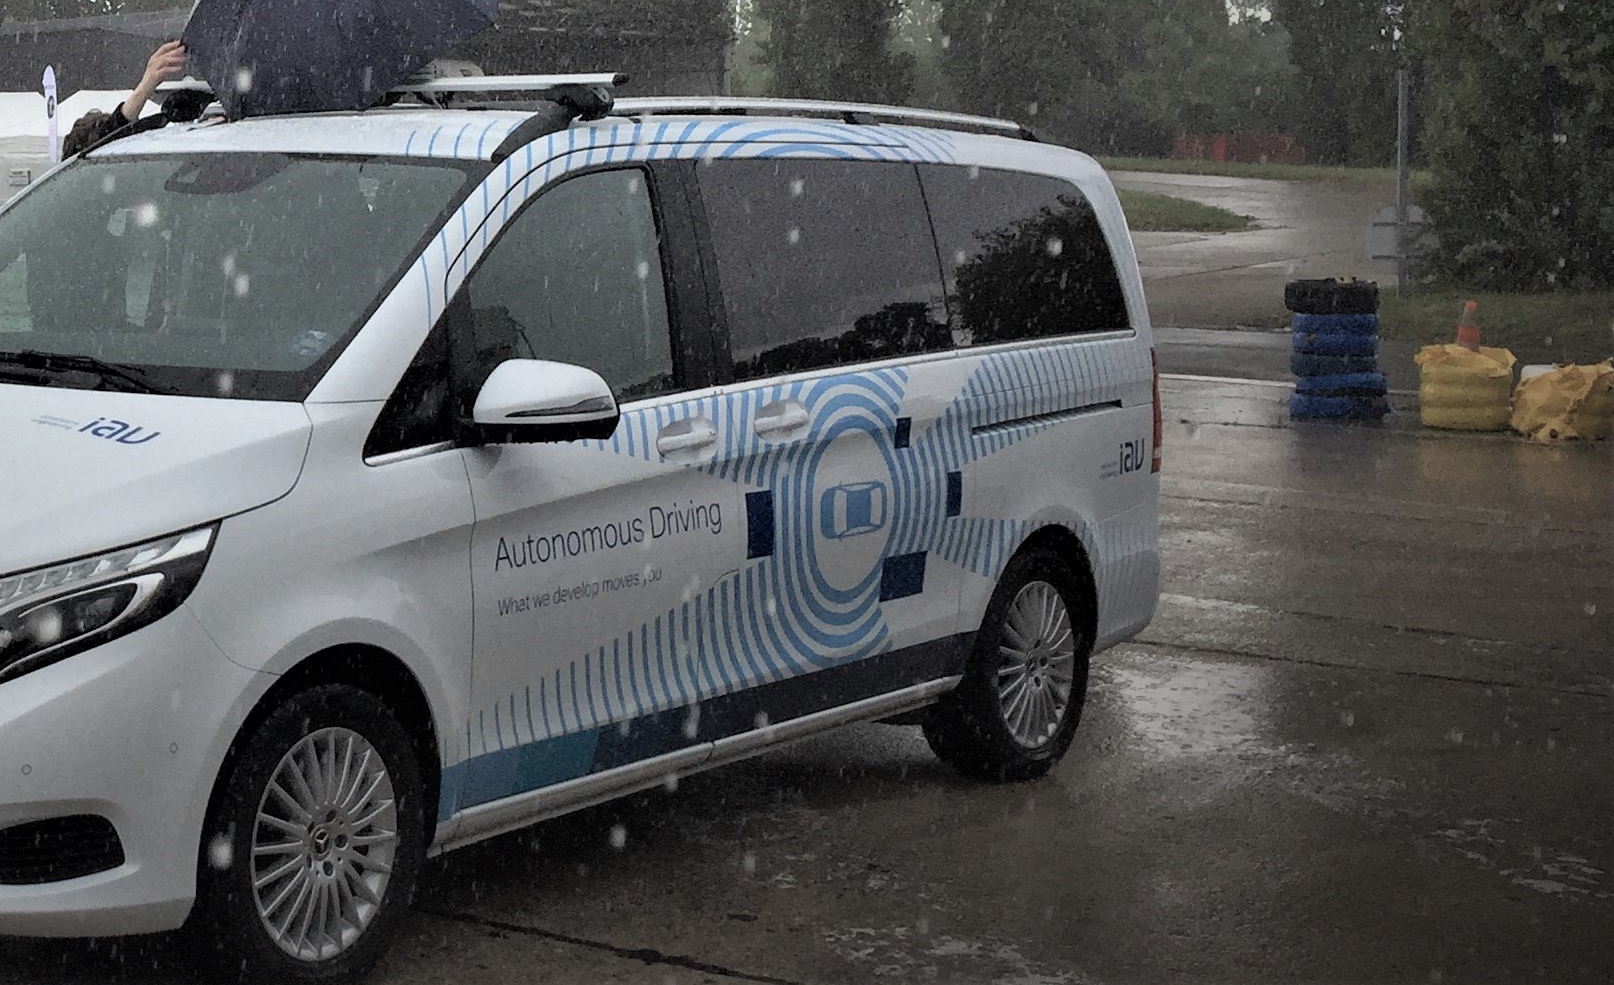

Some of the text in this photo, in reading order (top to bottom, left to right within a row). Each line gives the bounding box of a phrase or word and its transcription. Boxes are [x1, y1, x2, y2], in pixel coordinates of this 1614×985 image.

[494, 500, 722, 571] Autonomous Driving
[533, 593, 549, 608] we
[553, 582, 599, 604] develop
[602, 572, 639, 593] moves
